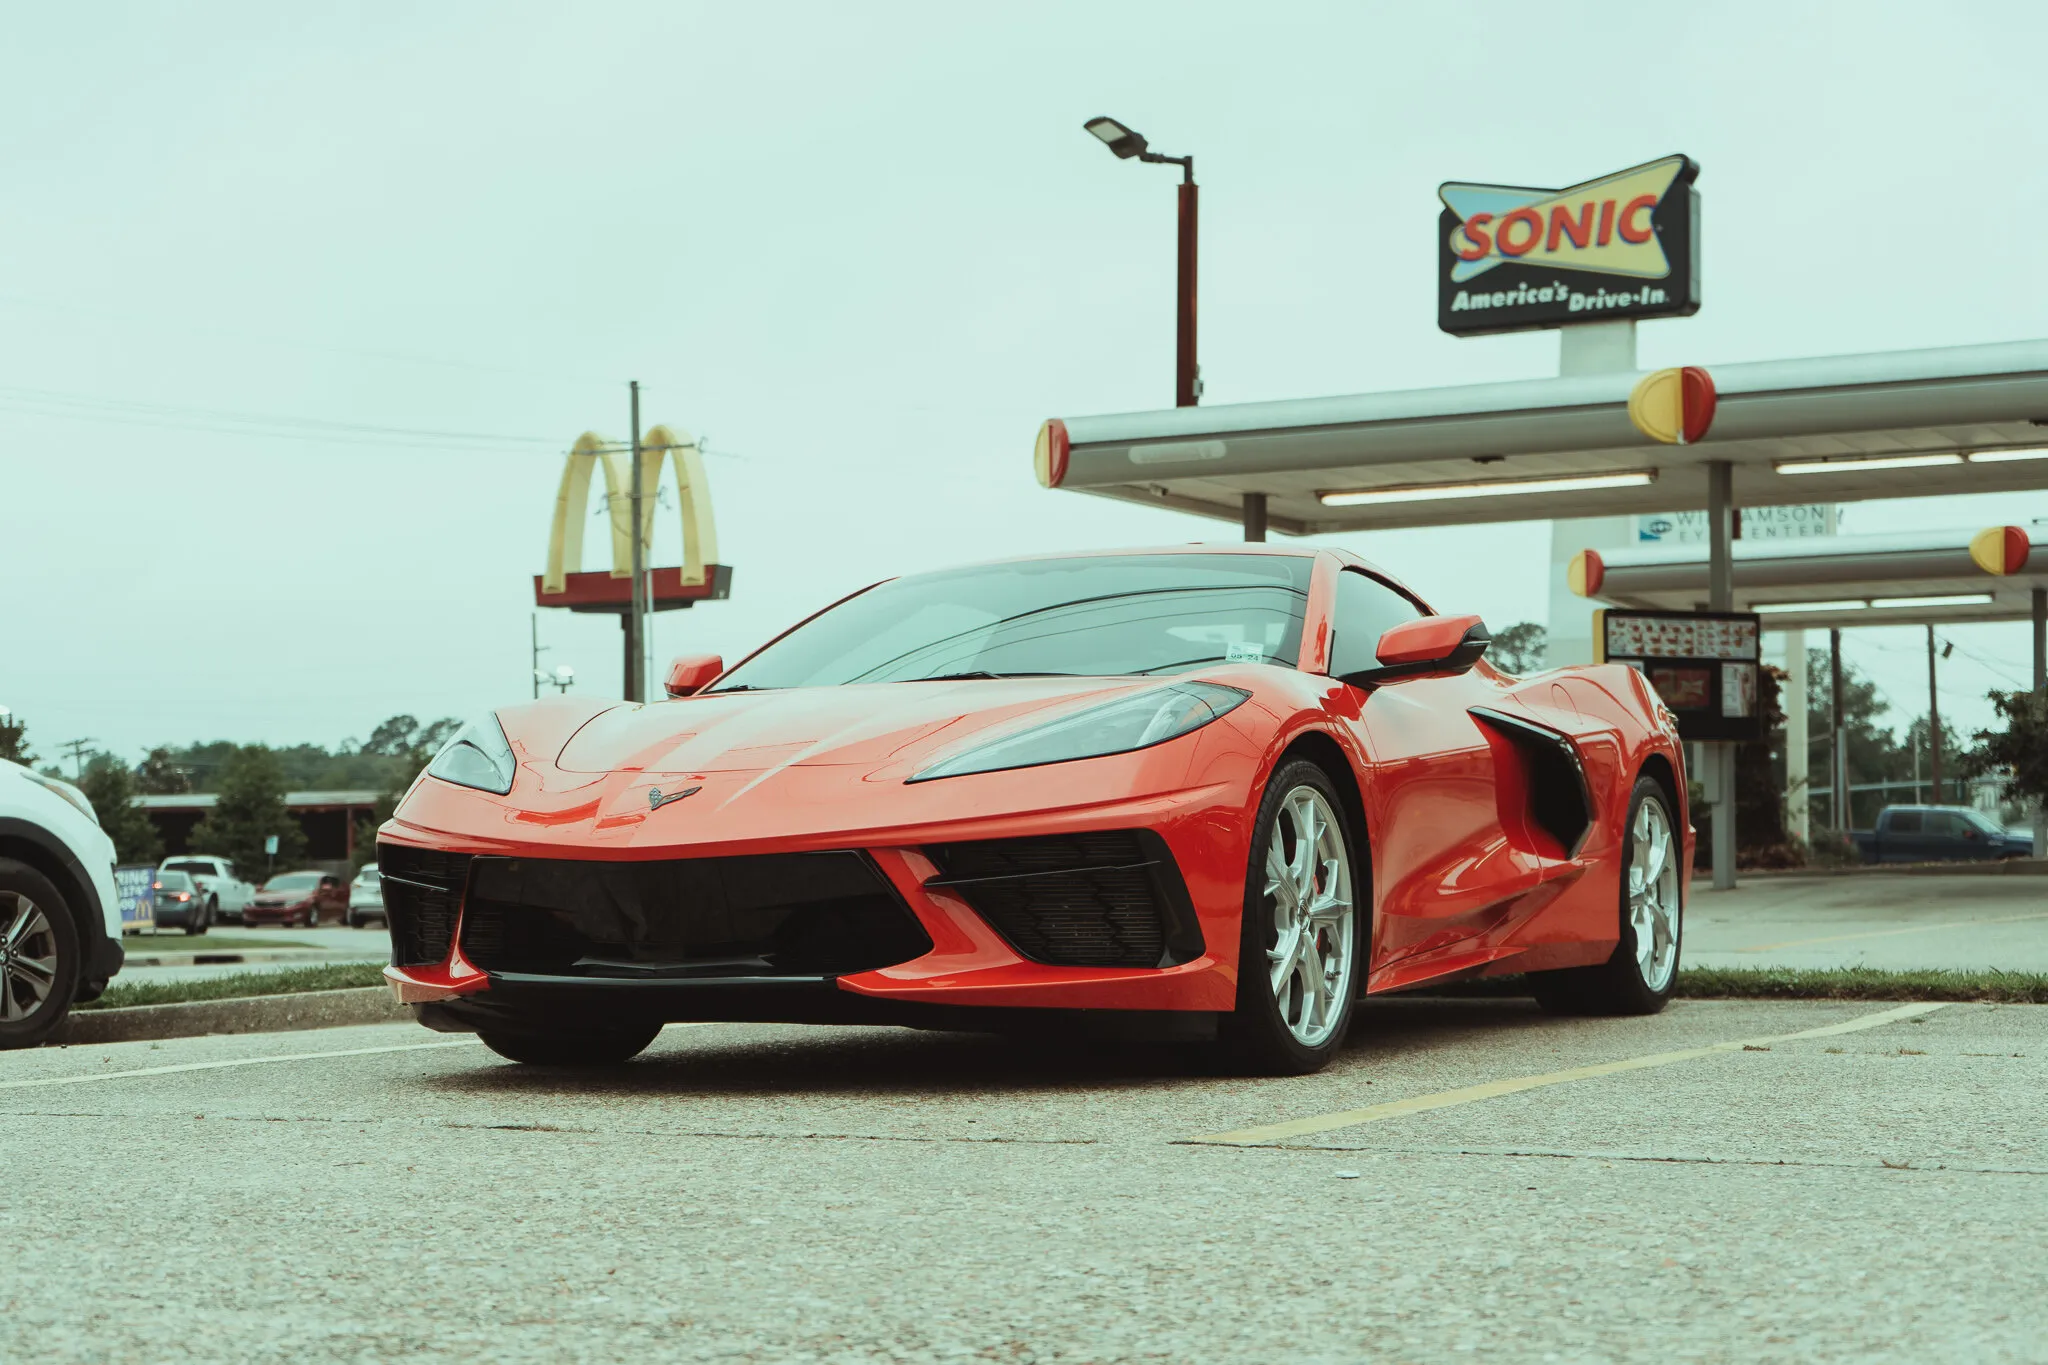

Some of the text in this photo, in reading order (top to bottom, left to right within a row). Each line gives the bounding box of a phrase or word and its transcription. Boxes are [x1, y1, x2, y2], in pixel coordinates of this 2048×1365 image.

[1457, 194, 1657, 261] SONIC
[1451, 280, 1569, 311] America's
[1744, 524, 1825, 540] ENTER
